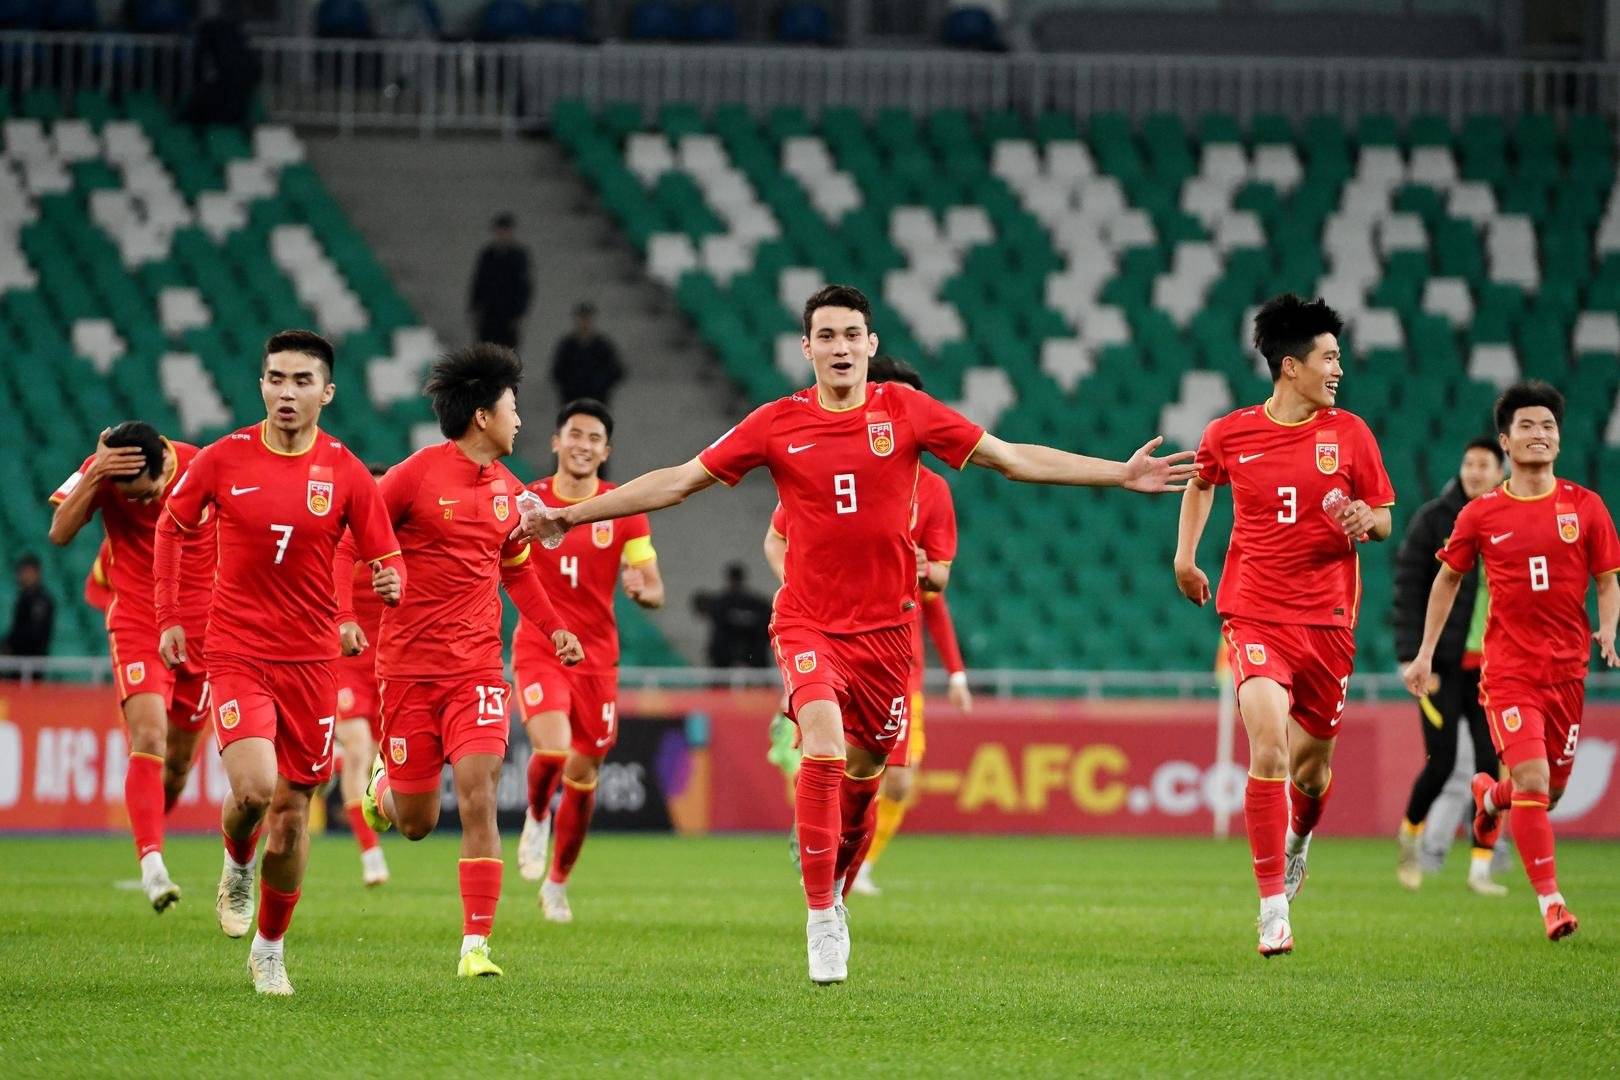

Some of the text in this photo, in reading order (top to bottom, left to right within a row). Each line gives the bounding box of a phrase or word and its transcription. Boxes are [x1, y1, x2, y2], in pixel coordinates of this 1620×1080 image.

[834, 474, 857, 514] 9
[1277, 486, 1297, 524] 3
[270, 524, 293, 564] 7
[560, 555, 578, 589] 4
[1528, 555, 1549, 592] 8
[476, 685, 505, 717] 13
[1336, 673, 1349, 713] 3
[602, 701, 616, 734] 4
[884, 696, 905, 730] 9
[318, 715, 335, 757] 7
[1563, 723, 1580, 757] 8
[915, 743, 1247, 815] -AFC.co
